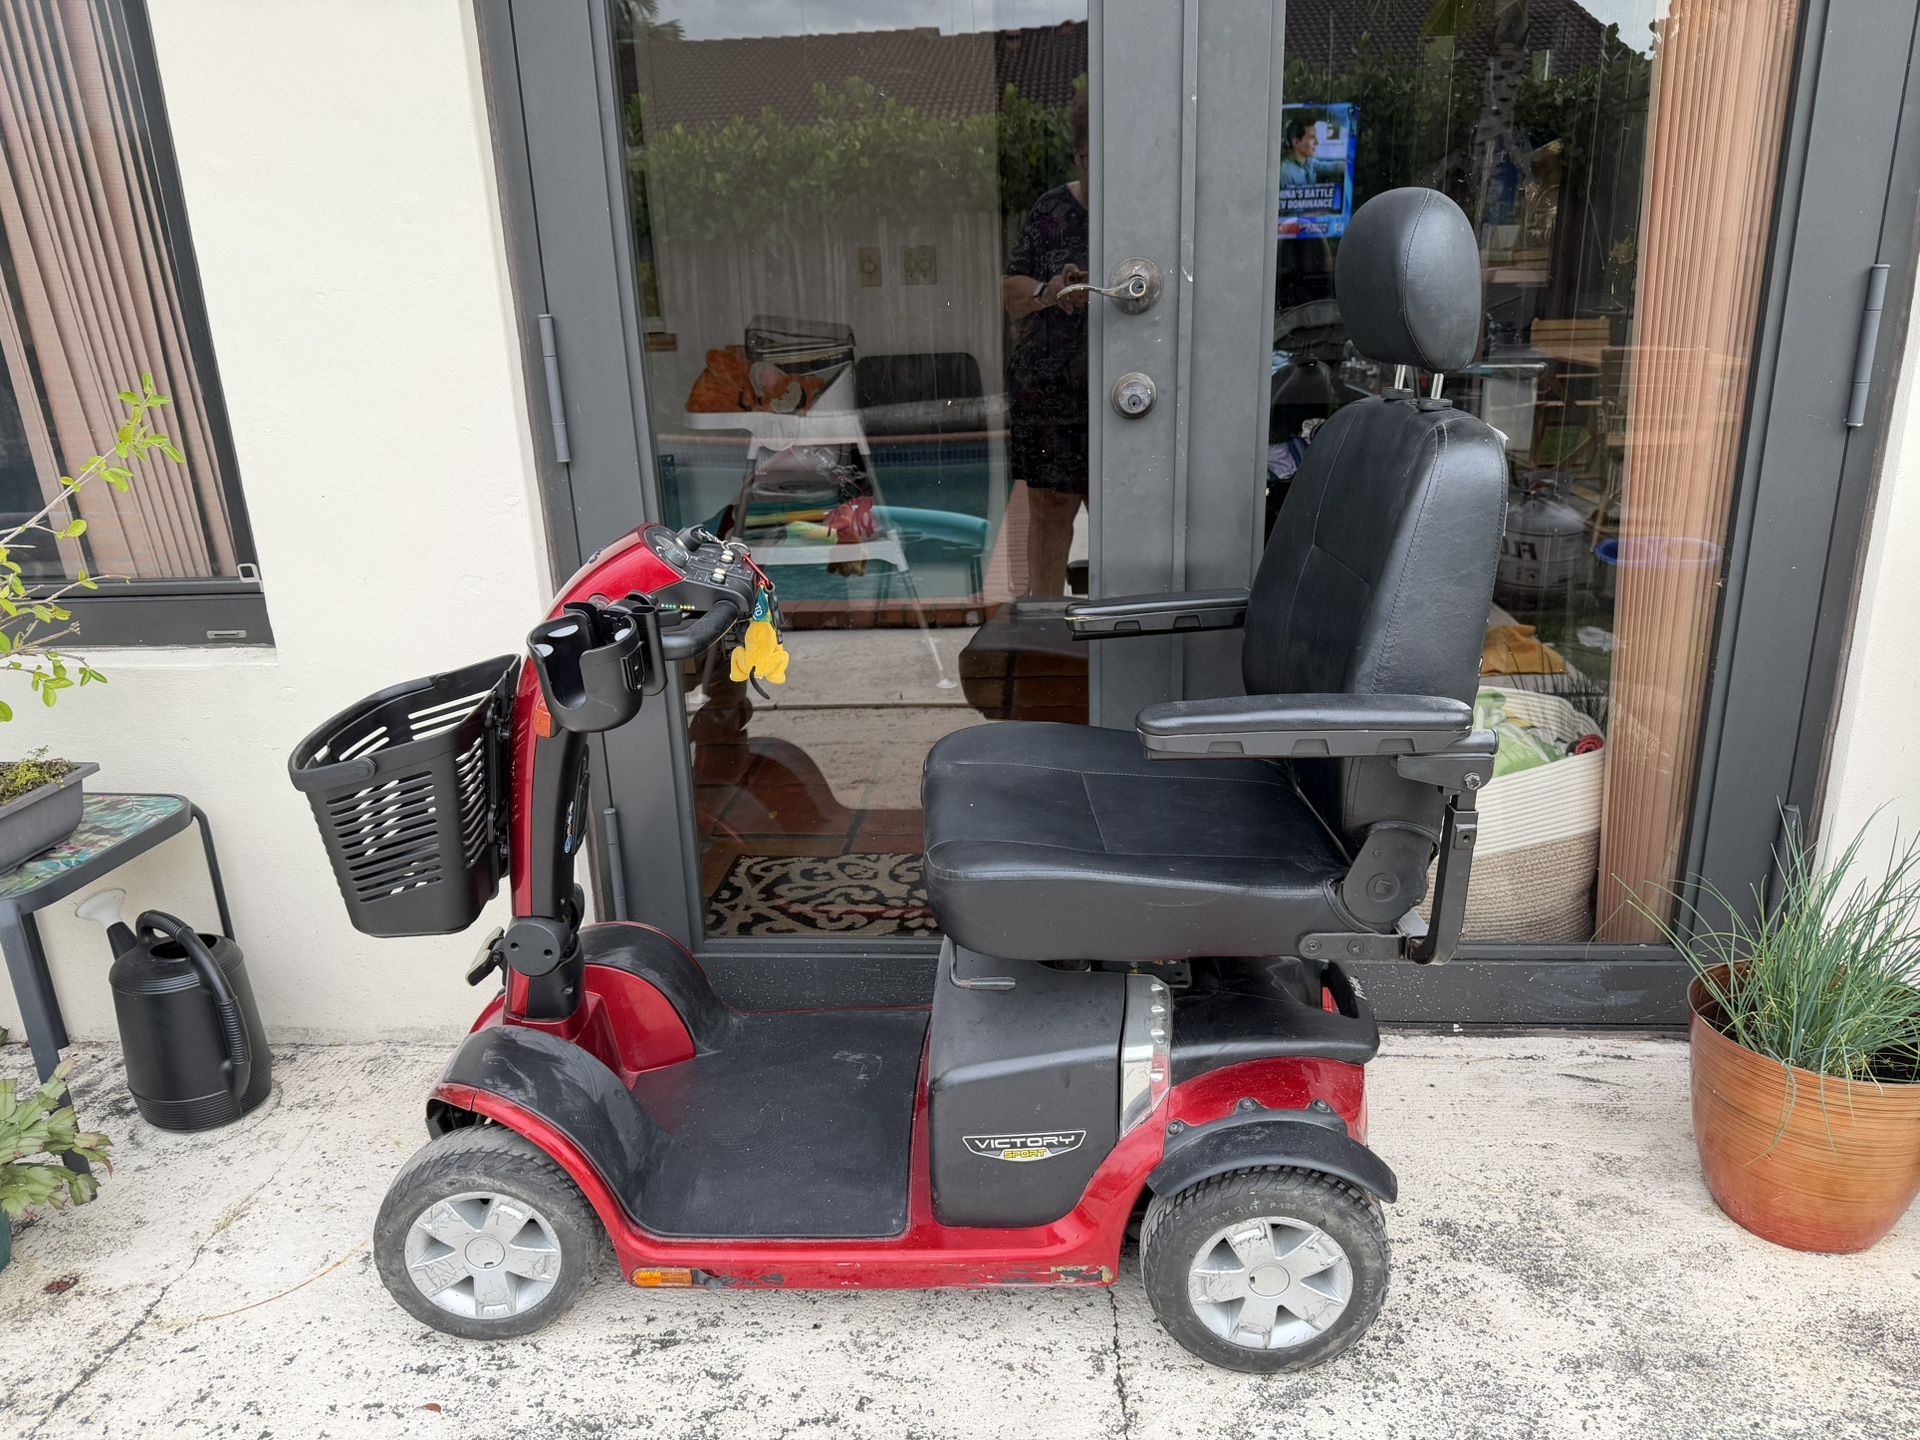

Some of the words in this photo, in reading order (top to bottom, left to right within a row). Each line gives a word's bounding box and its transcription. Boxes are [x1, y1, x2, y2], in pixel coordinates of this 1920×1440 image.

[1304, 188, 1334, 198] BATTLE
[1288, 199, 1333, 209] DOMINANCE
[1349, 976, 1367, 1000] Pride
[974, 1135, 1075, 1149] VICTORY
[1003, 1150, 1047, 1159] SPORT
